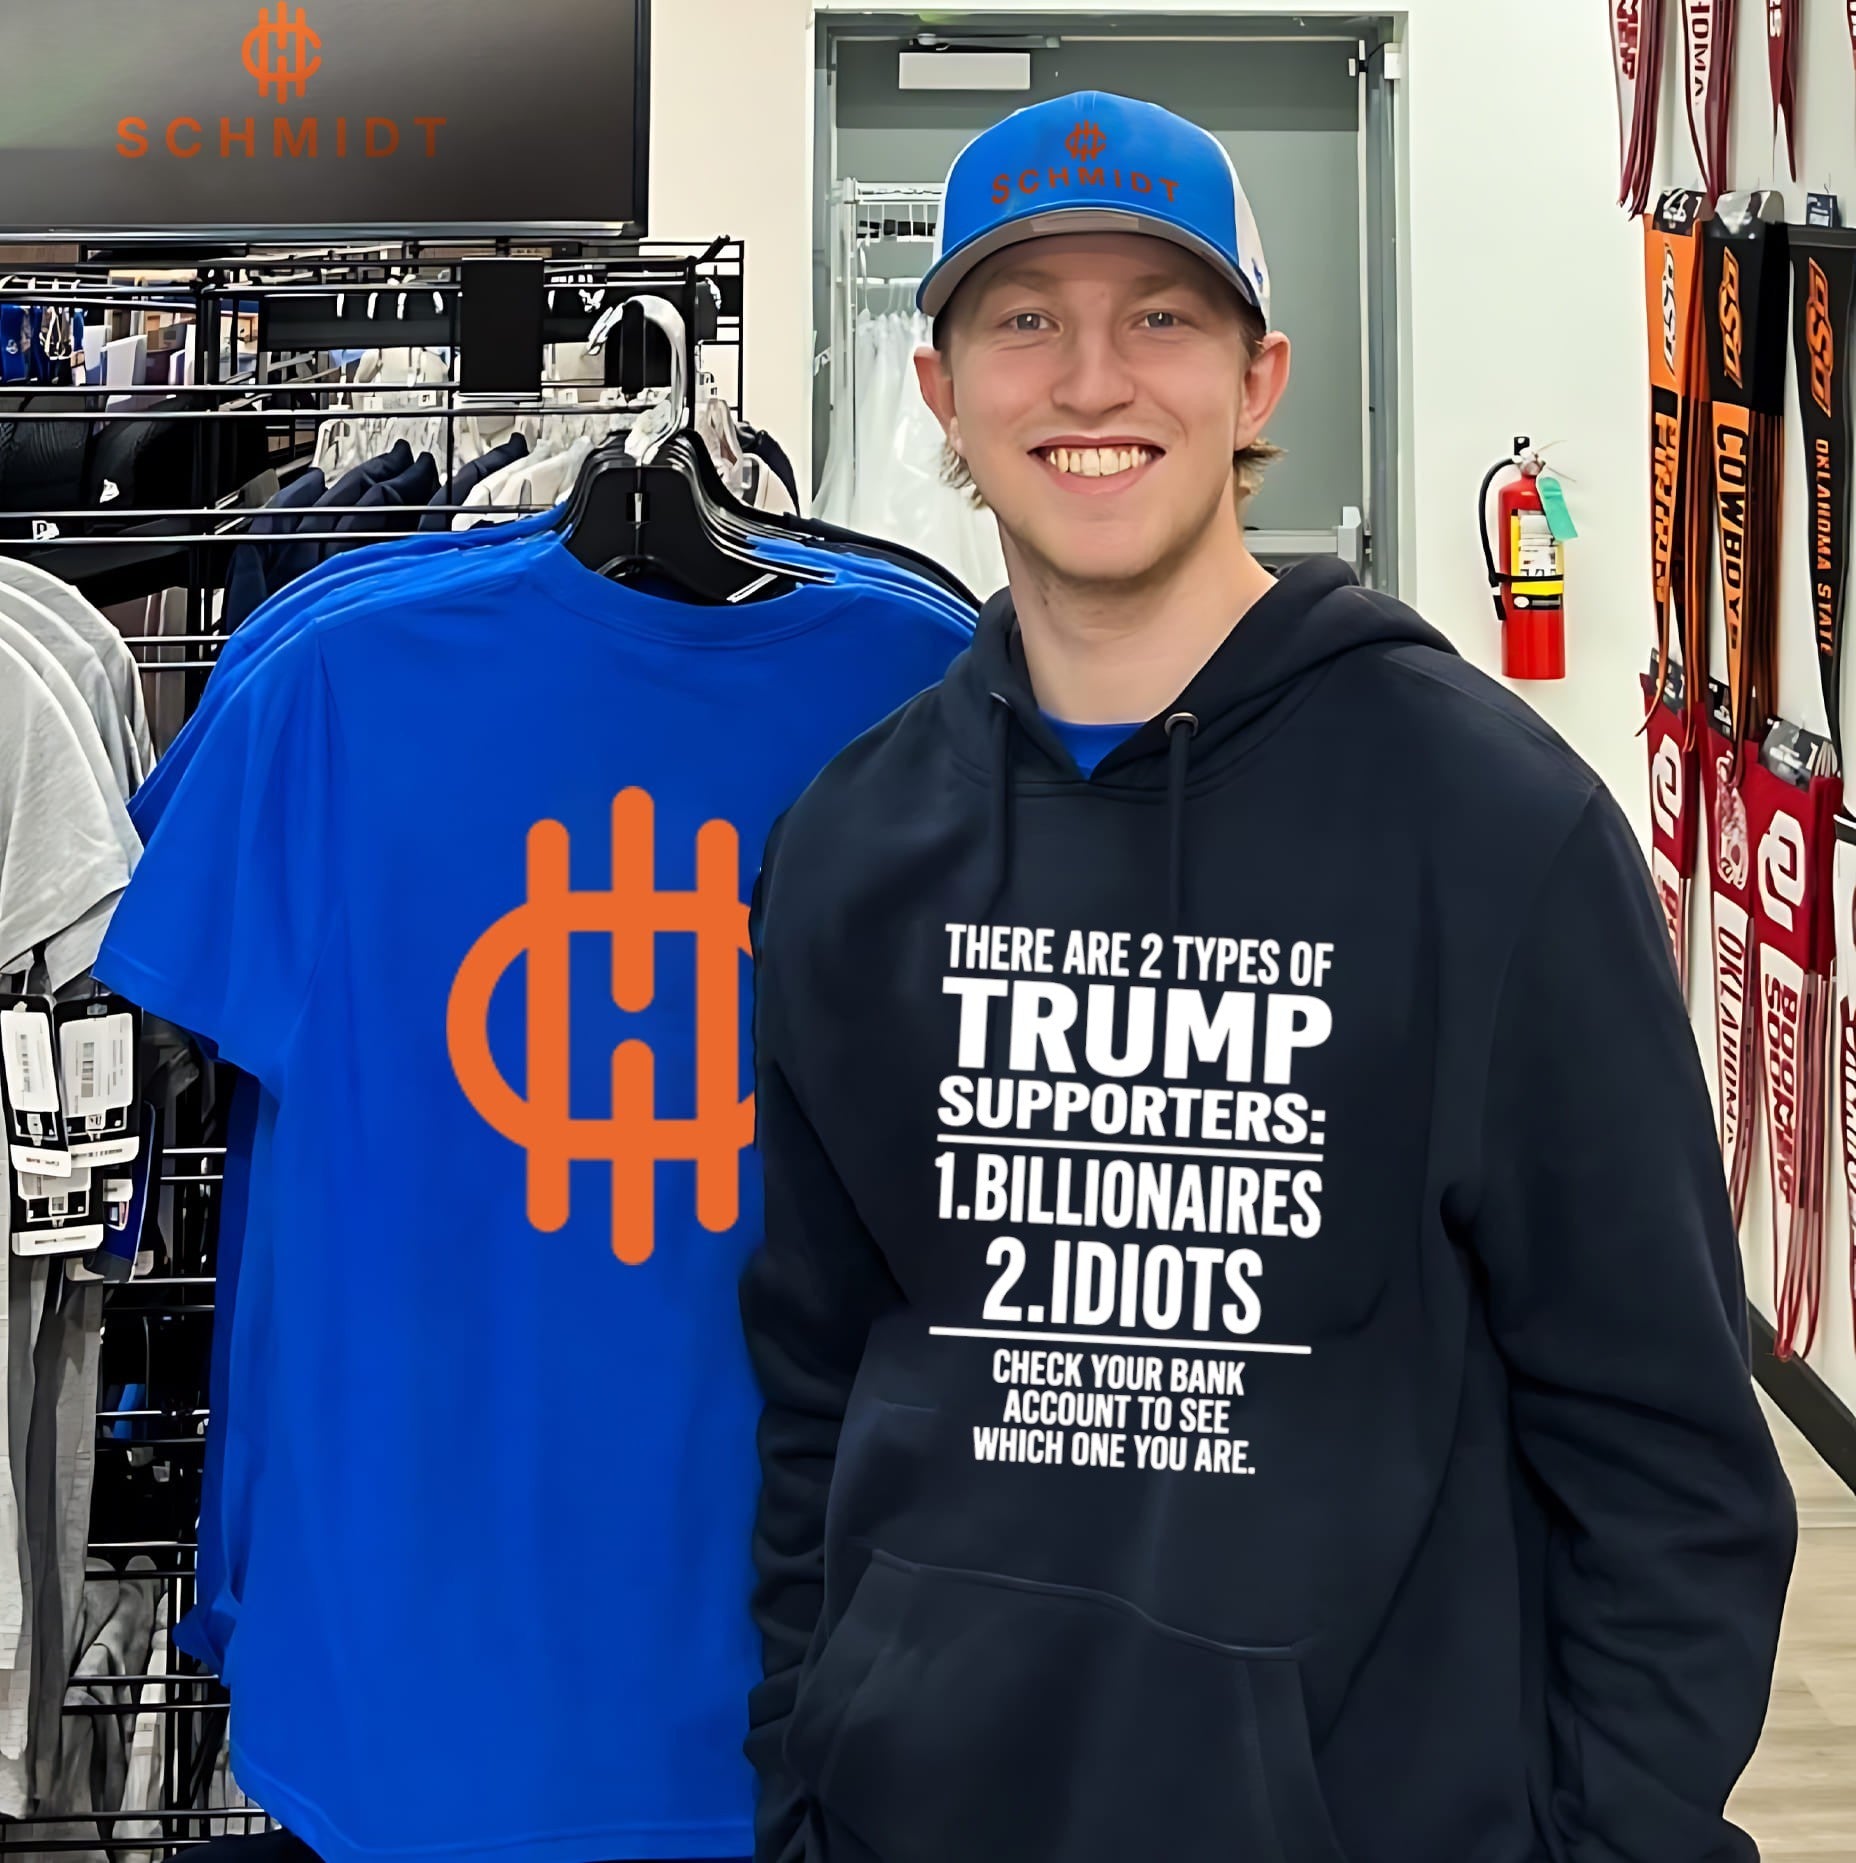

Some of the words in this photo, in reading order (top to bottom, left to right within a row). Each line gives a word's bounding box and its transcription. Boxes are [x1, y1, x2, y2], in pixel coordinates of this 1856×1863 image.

[116, 116, 447, 159] SCHMIDT
[992, 167, 1178, 204] SCHMIDT
[1815, 438, 1832, 570] OKLAHOMA
[944, 923, 1055, 974] THERE
[1063, 929, 1132, 978] ARE
[1139, 932, 1163, 979] 2
[1172, 935, 1280, 986] TYPES
[1289, 940, 1335, 988] OF
[942, 976, 1333, 1085] TRUMP
[1718, 925, 1745, 1144] OKLAHOMA
[937, 1075, 1326, 1146] SUPPORTERS:
[992, 1348, 1084, 1388] CHECK
[1090, 1353, 1164, 1392] YOUR
[1169, 1357, 1246, 1396] BANK
[1002, 1388, 1132, 1429] ACCOUNT
[1137, 1395, 1173, 1432] TO
[1179, 1397, 1231, 1435] SEE
[973, 1425, 1064, 1465] WHICH
[1071, 1431, 1127, 1468] ONE
[1133, 1434, 1188, 1471] YOU
[1193, 1437, 1256, 1475] ARE.
